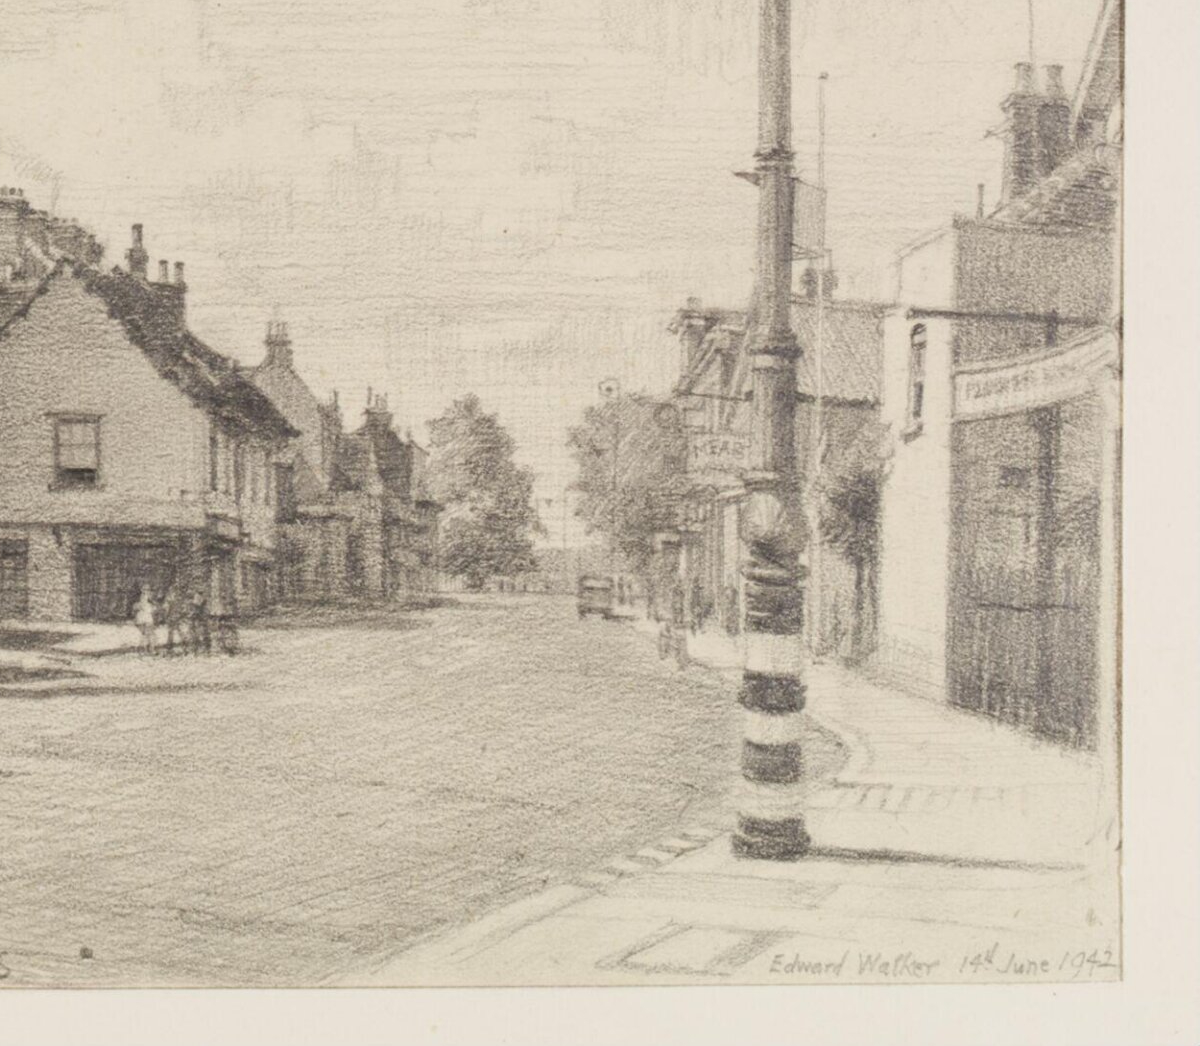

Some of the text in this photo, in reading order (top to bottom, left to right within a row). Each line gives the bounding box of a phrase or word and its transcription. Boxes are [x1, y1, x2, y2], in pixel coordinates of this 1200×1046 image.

[768, 949, 851, 977] Edward
[856, 950, 941, 979] Walker
[996, 953, 1051, 976] June
[1057, 944, 1118, 979] 1942
